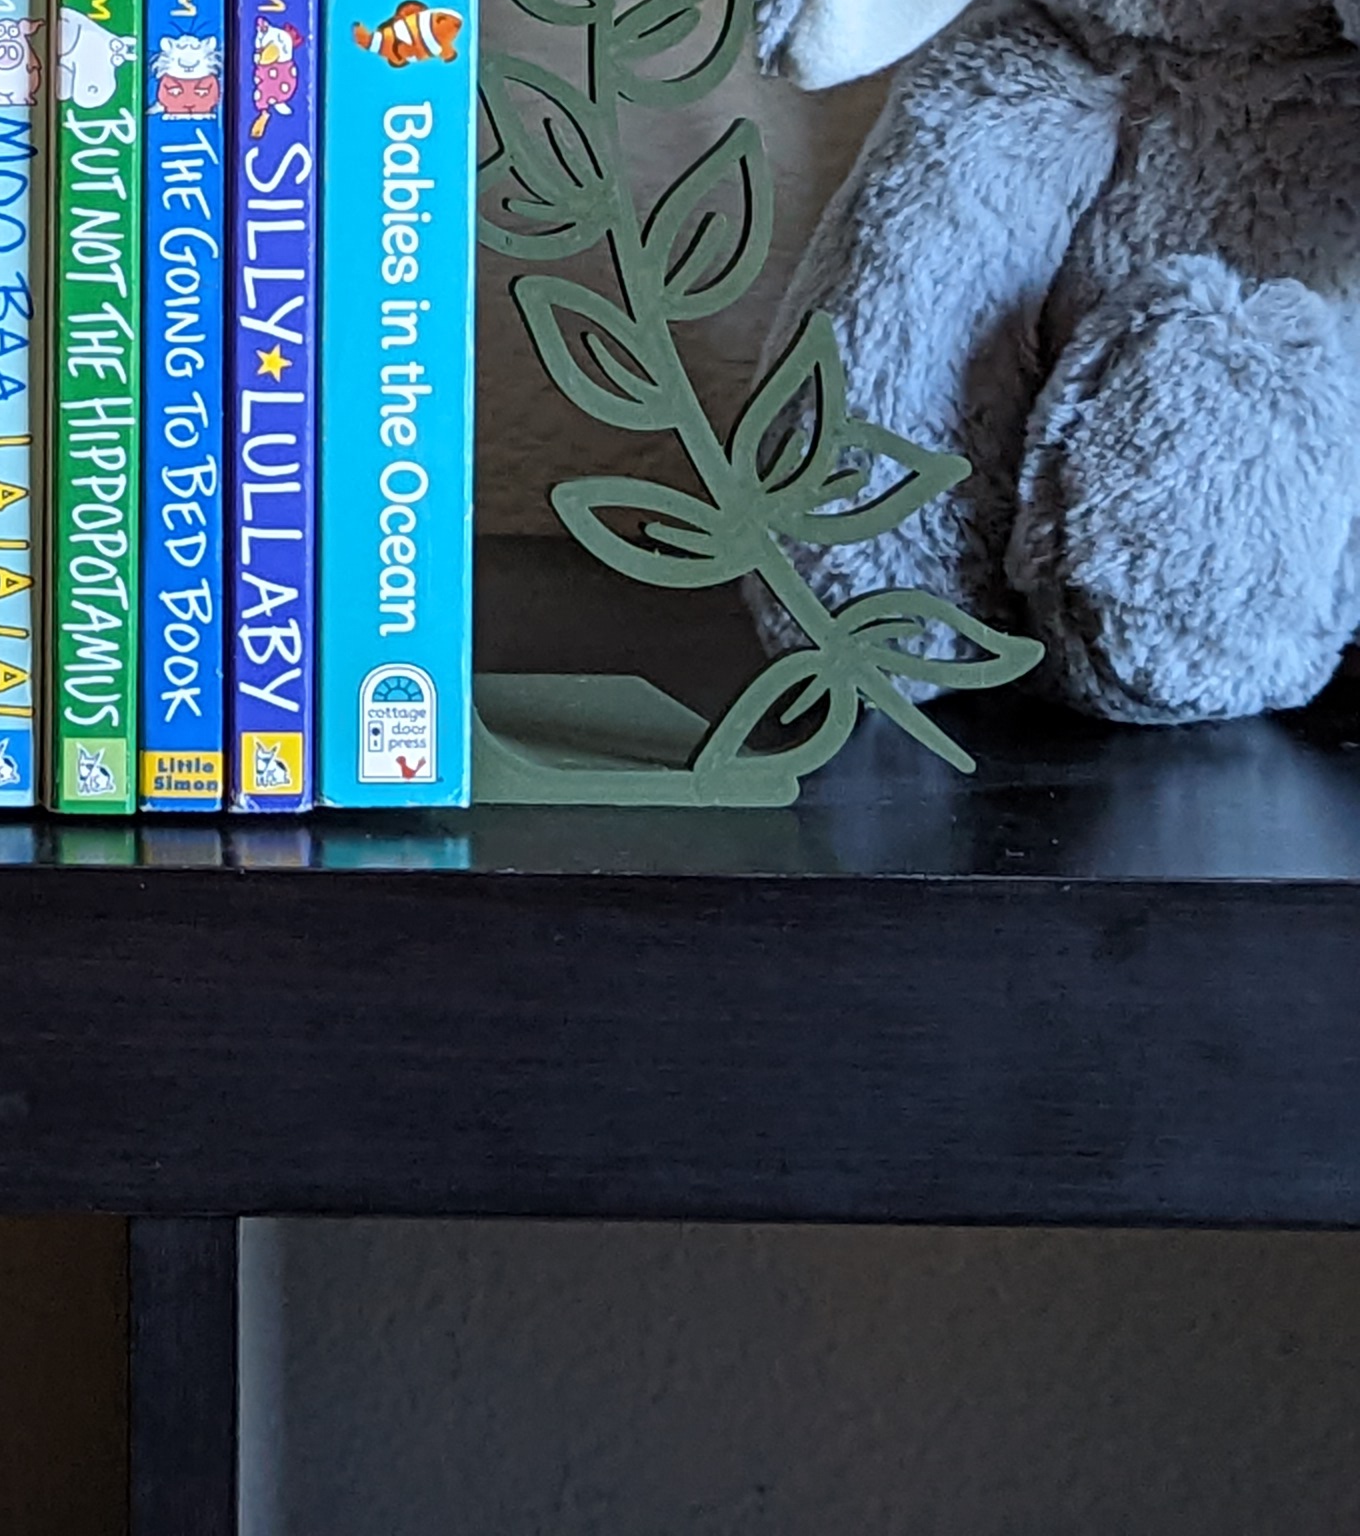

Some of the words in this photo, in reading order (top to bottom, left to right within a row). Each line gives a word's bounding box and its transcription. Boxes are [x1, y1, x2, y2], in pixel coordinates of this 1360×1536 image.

[62, 107, 137, 200] BUT
[160, 127, 219, 221] THE
[381, 101, 435, 285] Babies
[65, 207, 128, 298] NOT
[239, 142, 312, 345] SILLY
[67, 301, 135, 385] THE
[381, 300, 431, 350] in
[379, 361, 432, 447] the
[161, 454, 218, 567] BED
[238, 389, 306, 713] LULLABY
[379, 460, 429, 638] Ocean
[60, 397, 136, 728] HIPPOPOTAMUS
[158, 578, 213, 723] BOOK
[368, 707, 426, 723] cottage
[389, 738, 426, 752] press
[392, 722, 426, 735] door
[154, 776, 218, 792] Simon
[158, 759, 214, 774] Little
